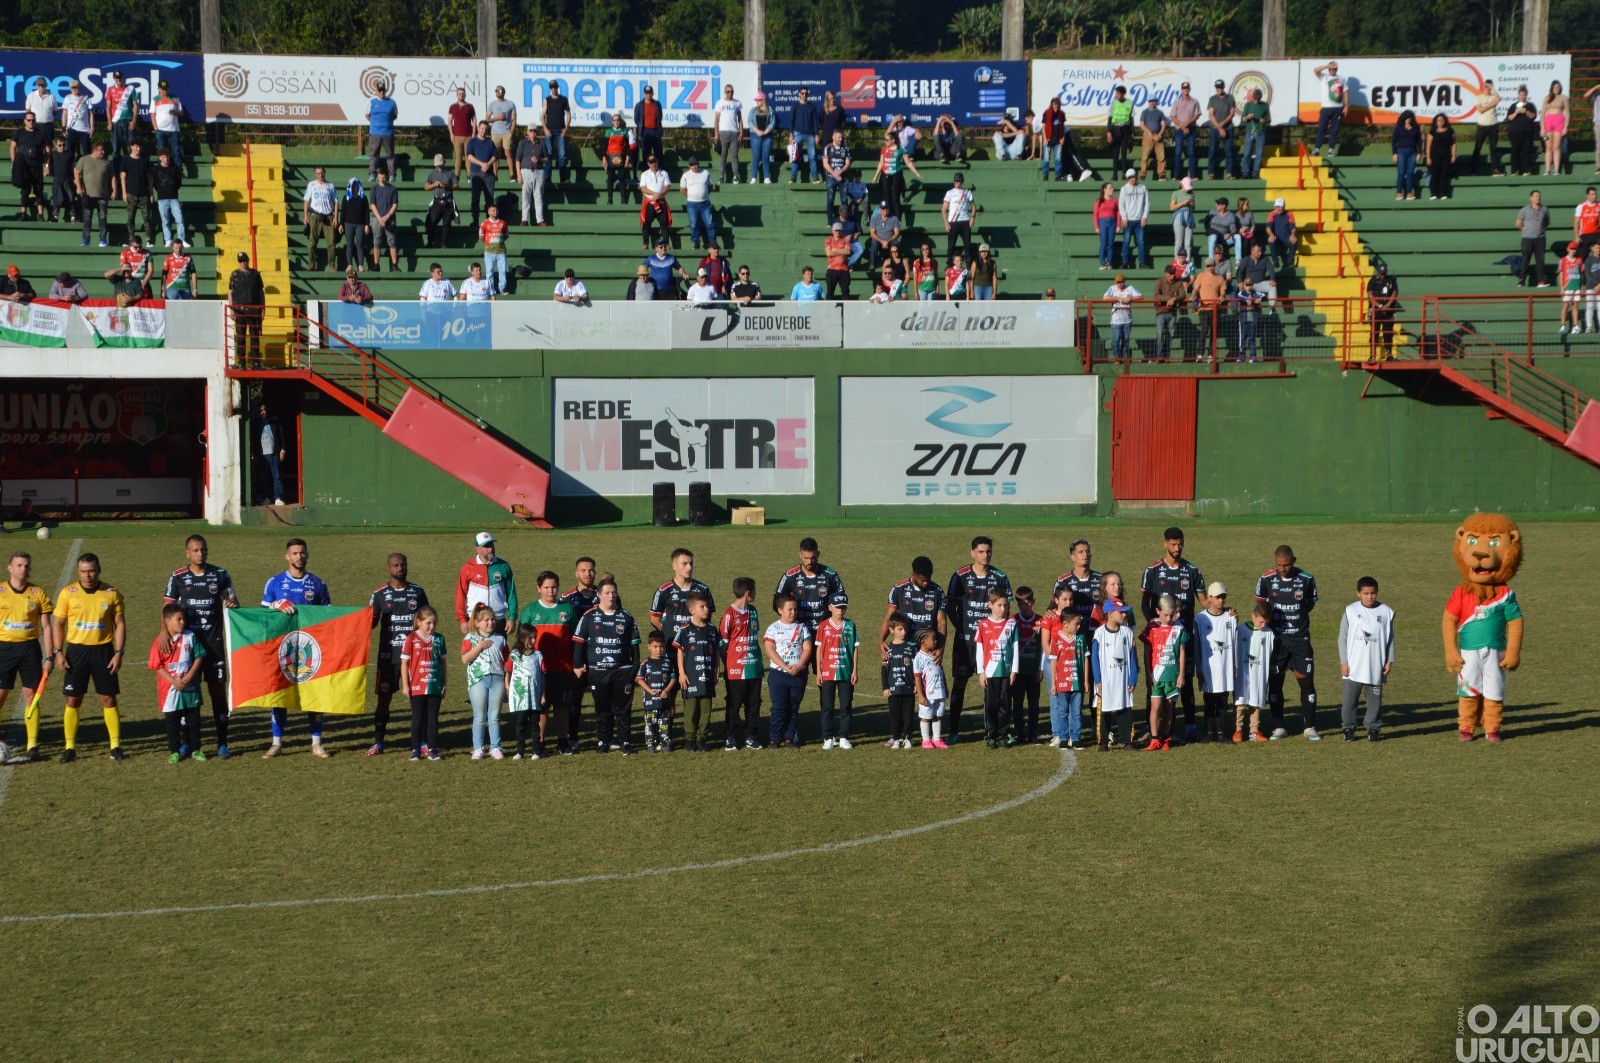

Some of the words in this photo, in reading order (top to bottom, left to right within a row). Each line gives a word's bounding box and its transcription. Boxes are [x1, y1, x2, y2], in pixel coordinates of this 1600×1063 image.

[259, 69, 335, 77] MADEIRAS
[526, 65, 558, 73] FILTROS
[560, 65, 569, 73] DE
[572, 64, 596, 74] ÁGUA
[605, 65, 644, 74] COLCHÕES
[646, 65, 706, 75] BIOQUÂNTICOS
[1062, 69, 1113, 80] FARINHA
[1514, 62, 1555, 71] 996488139
[0, 66, 160, 106] reeStal
[257, 76, 337, 95] OSSANI
[404, 79, 481, 97] OSSANI
[876, 79, 951, 99] SCHERER
[911, 96, 951, 106] AUTOPEÇAS
[1371, 84, 1463, 107] ESTIVAL
[244, 104, 261, 117] (55)
[264, 104, 310, 117] 3199-1000
[441, 317, 466, 341] 10
[466, 322, 487, 334] Anos
[744, 315, 774, 330] DEDO
[775, 315, 811, 330] VERDE
[900, 311, 957, 331] dalla
[964, 314, 1018, 331] nora
[0, 384, 118, 430] UNIÃO
[563, 400, 632, 420] REDE
[46, 430, 112, 451] sempre
[563, 418, 809, 472] MESTRE
[905, 442, 1027, 477] ZACA
[905, 482, 1017, 497] SPORTS
[217, 668, 224, 679] 3
[1306, 663, 1312, 673] 9
